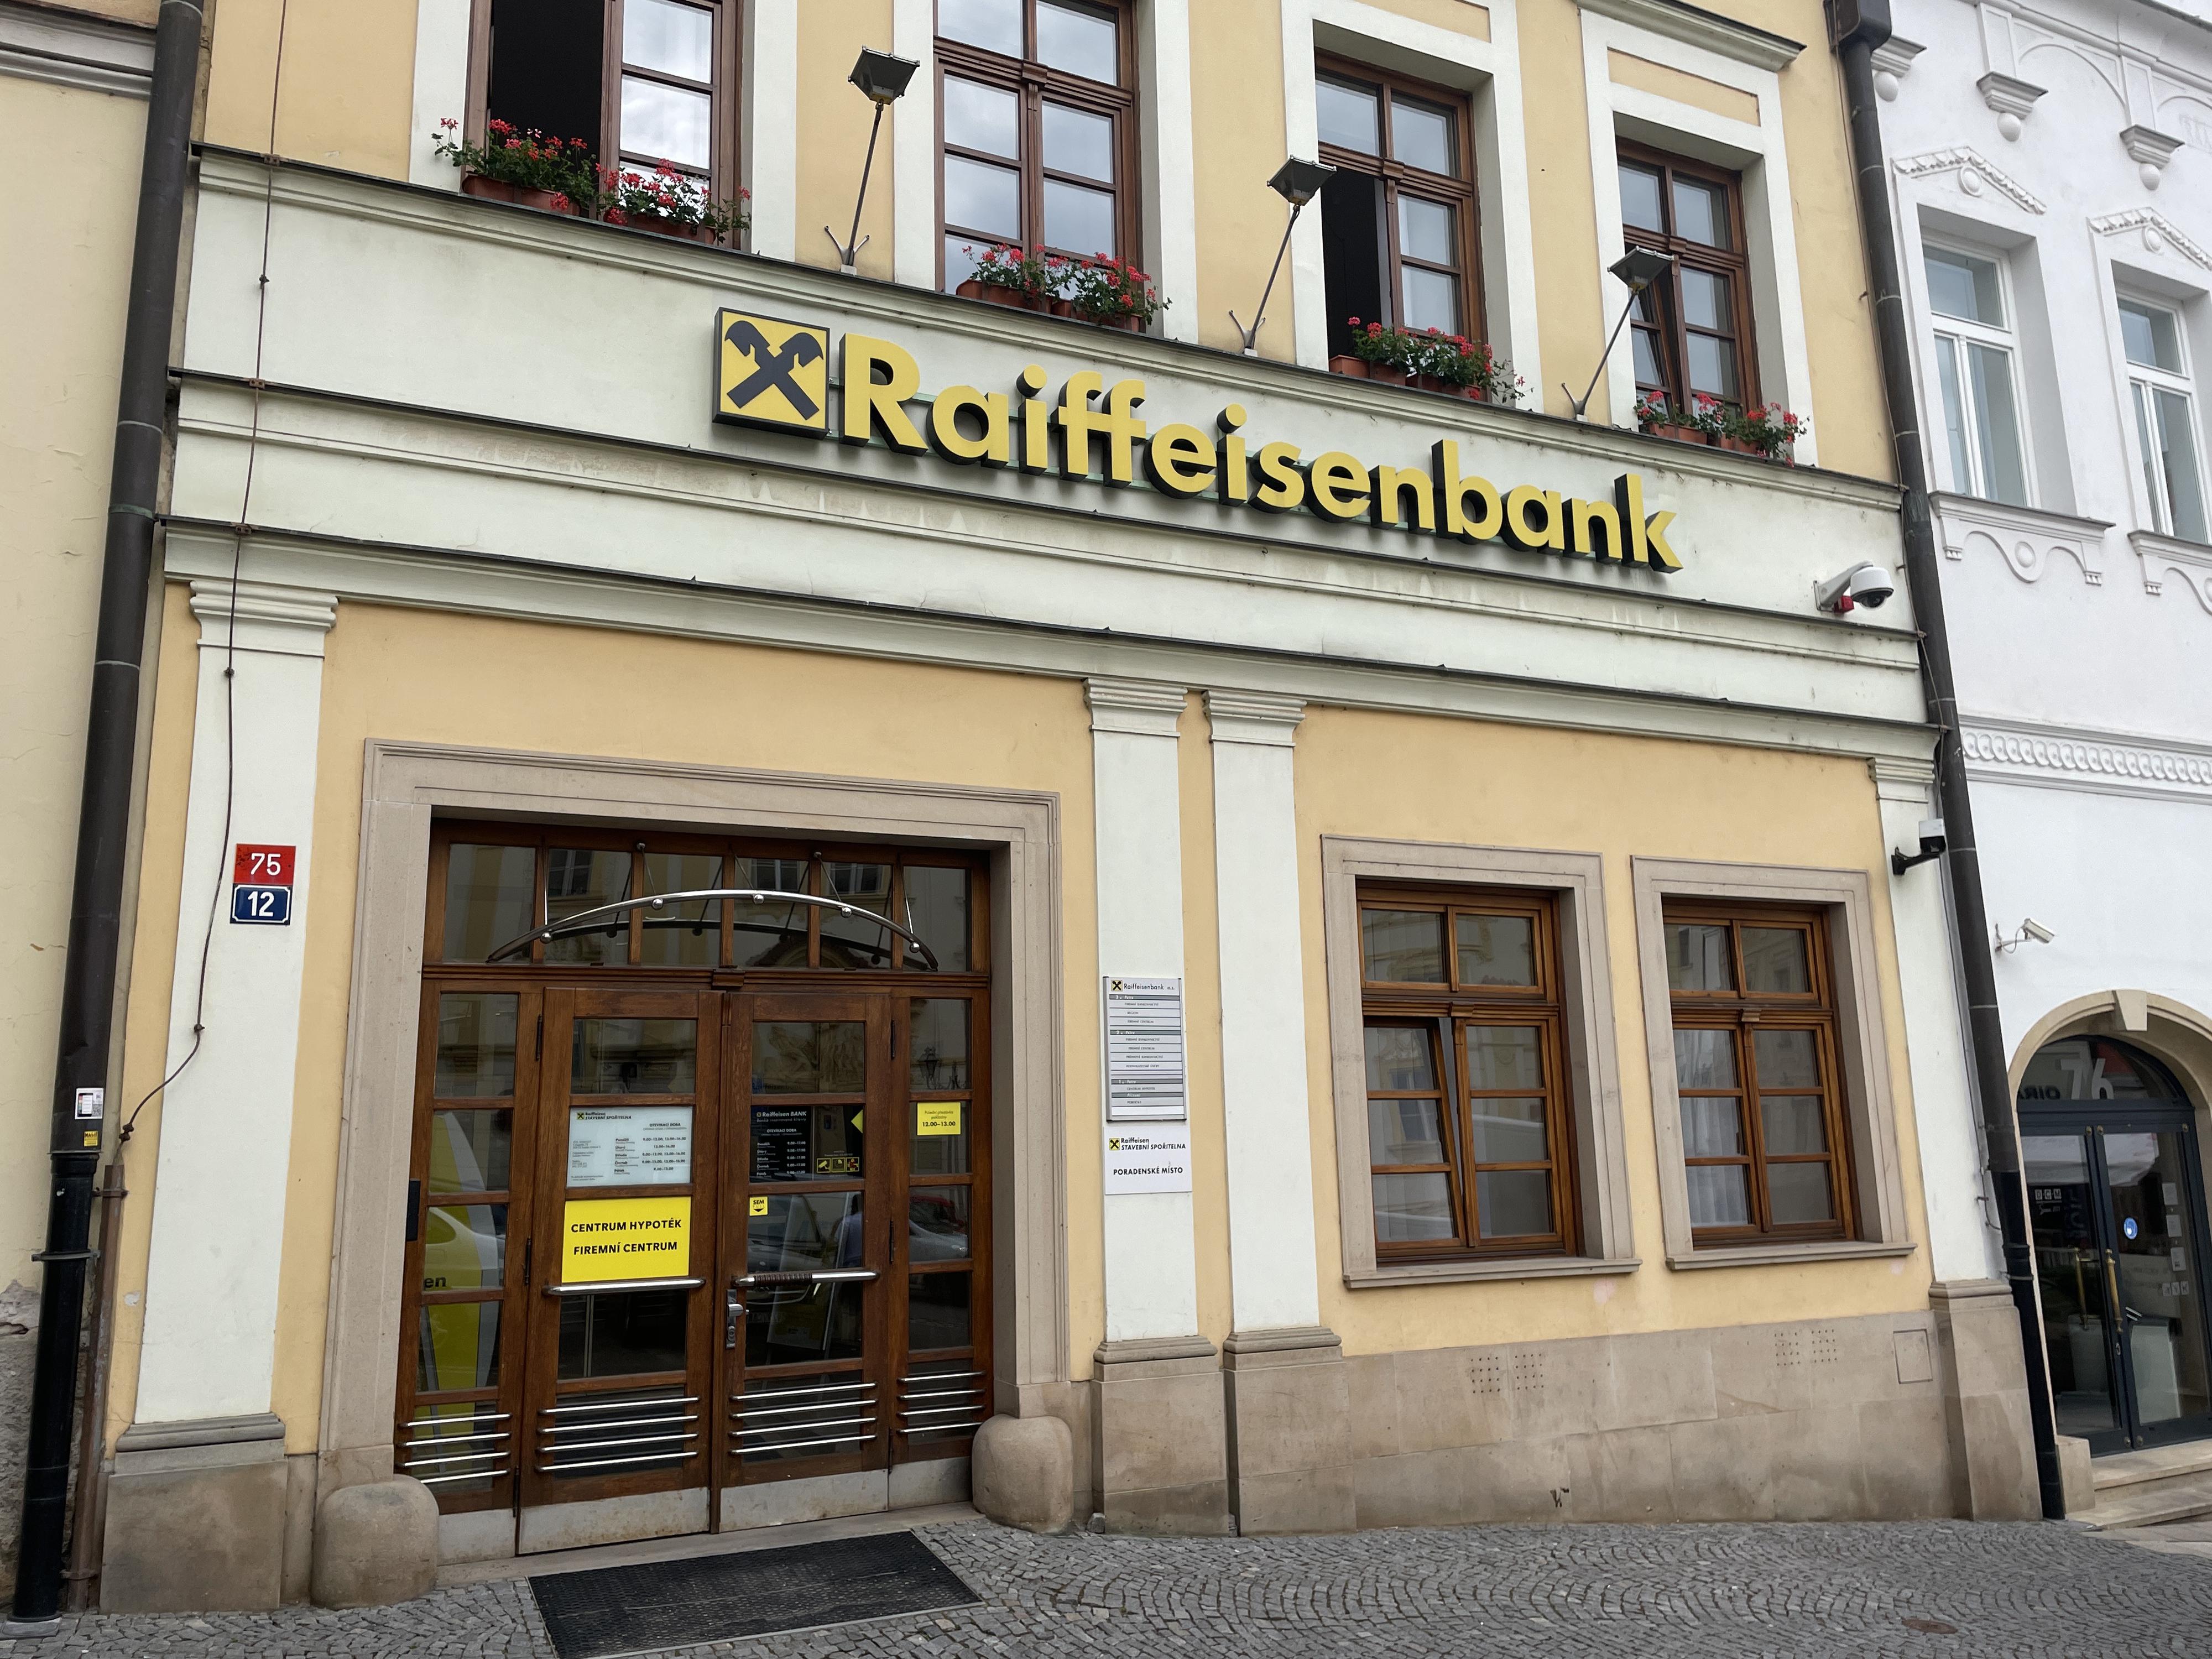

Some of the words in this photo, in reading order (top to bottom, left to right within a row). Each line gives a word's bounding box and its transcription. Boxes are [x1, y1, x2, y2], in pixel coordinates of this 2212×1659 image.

[839, 333, 1684, 573] Raiffeisenbank
[251, 853, 281, 875] 75
[247, 891, 274, 916] 12
[2060, 1058, 2114, 1099] 76
[1113, 1166, 1160, 1175] PORADENSKÉ
[1161, 1165, 1183, 1174] MÍSTO
[571, 1222, 626, 1233] CENTRUM
[629, 1217, 682, 1230] HYPOTÉK
[573, 1242, 620, 1255] FIREMNÍ
[623, 1241, 677, 1253] CENTRUM
